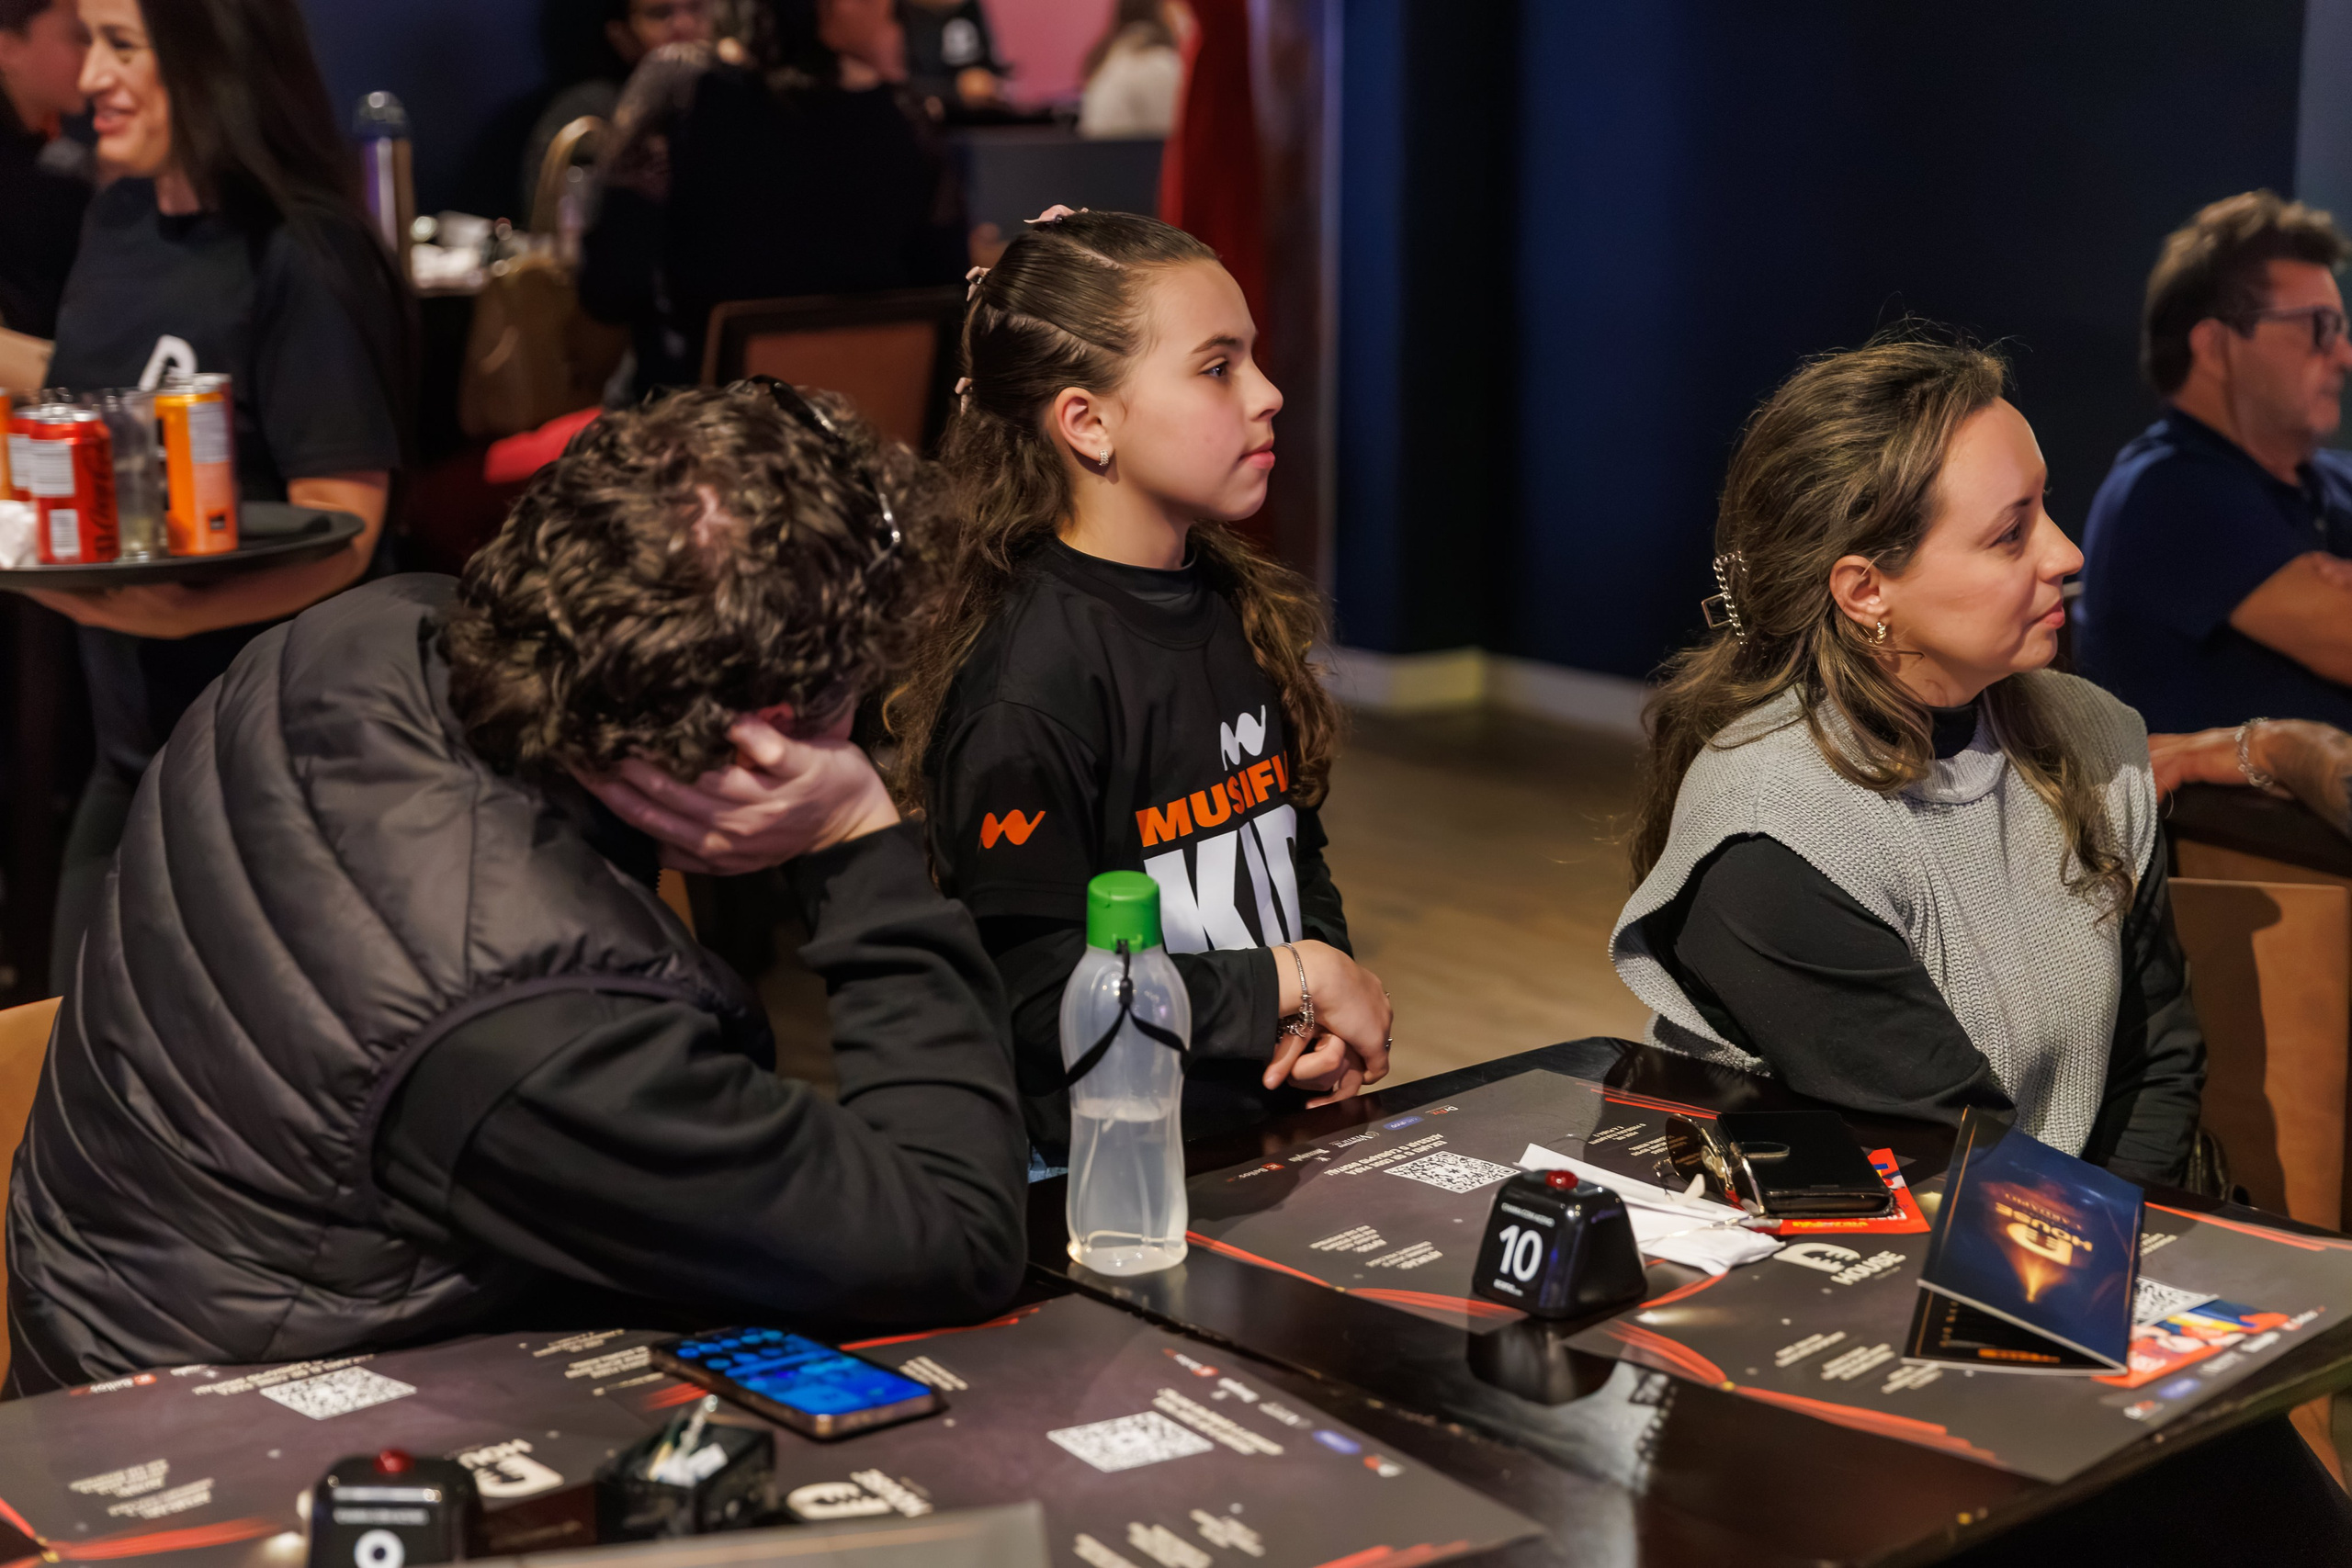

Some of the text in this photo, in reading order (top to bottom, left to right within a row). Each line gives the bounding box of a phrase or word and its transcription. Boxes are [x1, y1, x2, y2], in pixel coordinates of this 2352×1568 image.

[1995, 1201, 2093, 1252] HOUSE
[1498, 1224, 1544, 1282] 10
[1830, 1250, 1906, 1286] HOUSE
